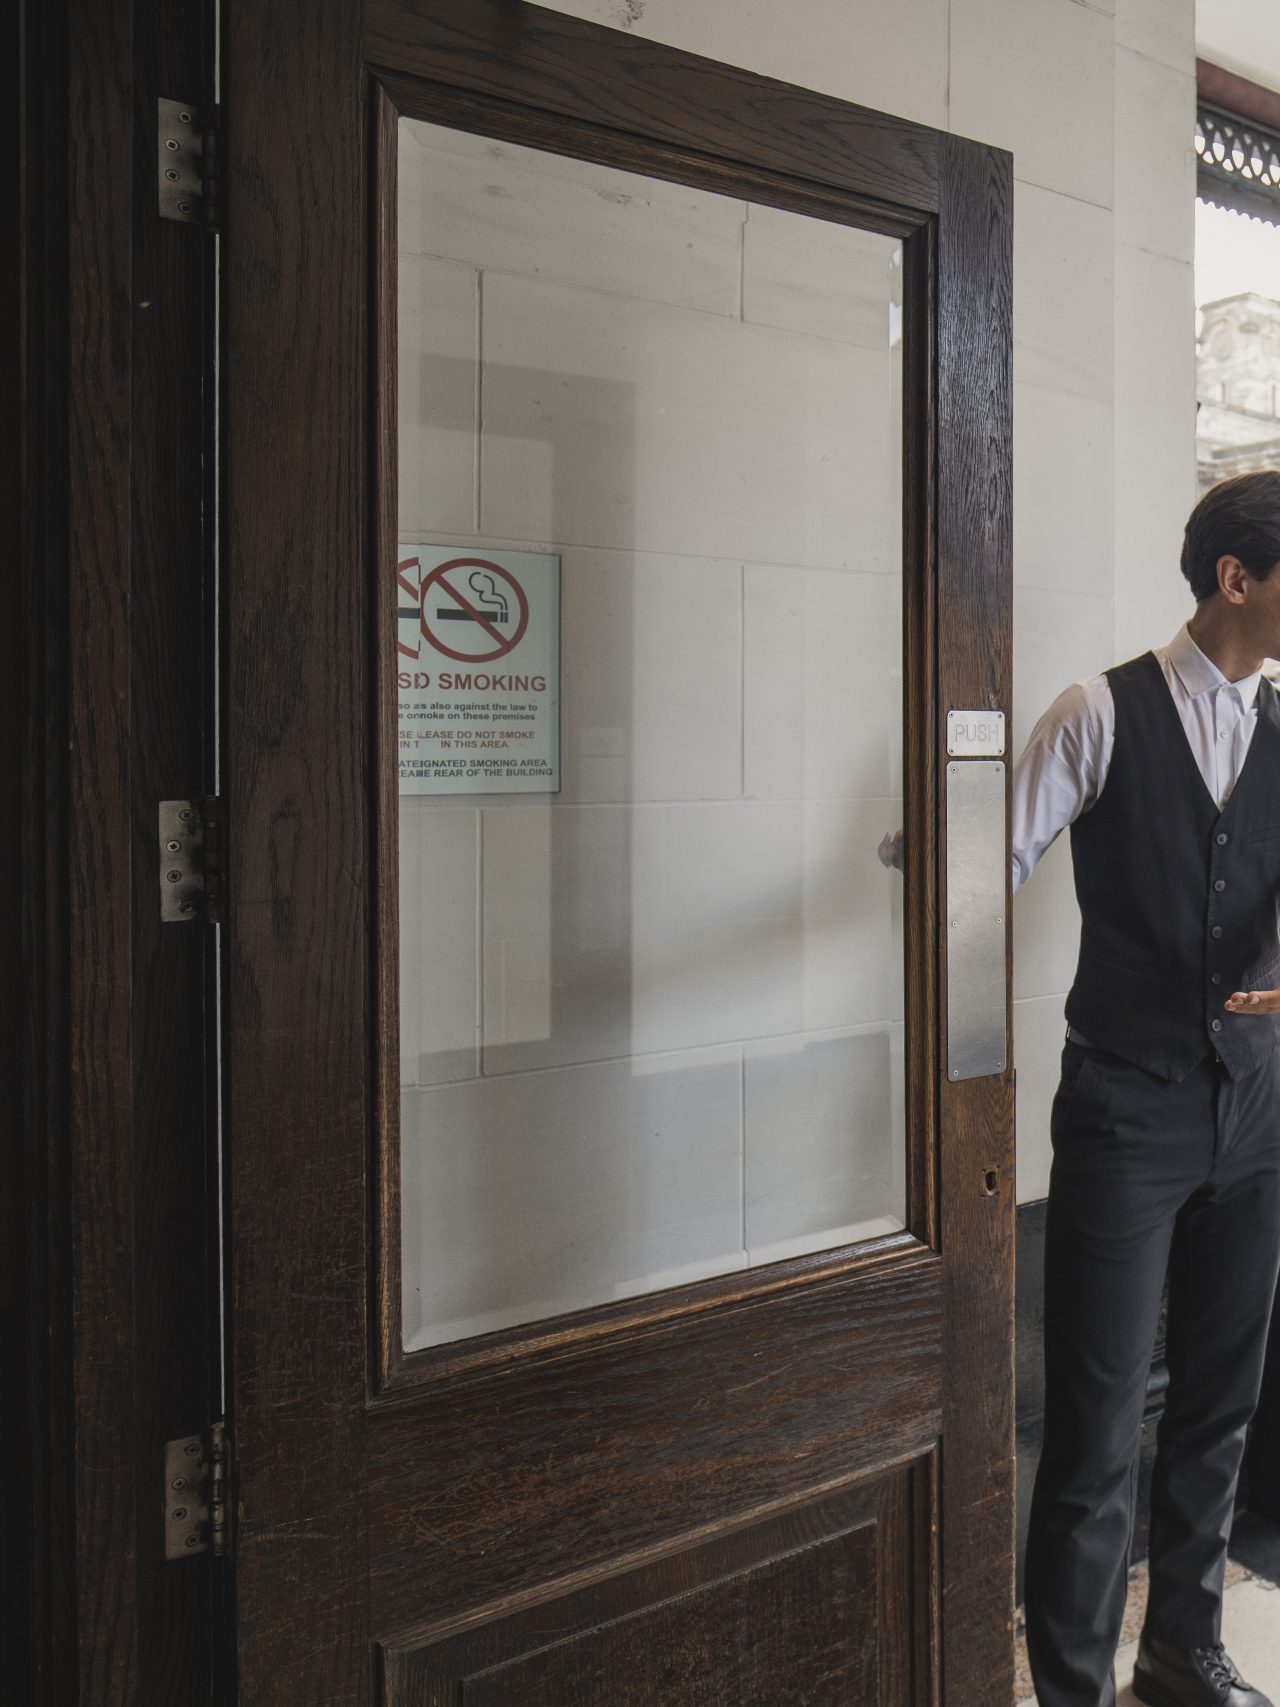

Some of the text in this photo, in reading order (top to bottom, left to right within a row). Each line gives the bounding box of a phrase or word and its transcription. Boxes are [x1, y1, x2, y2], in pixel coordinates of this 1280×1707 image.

[438, 673, 547, 692] SMOKING
[430, 702, 451, 710] also
[454, 703, 490, 711] against
[492, 703, 507, 711] the
[510, 703, 526, 711] law
[463, 712, 489, 720] these
[492, 713, 536, 721] premises
[457, 731, 472, 739] DO
[475, 731, 496, 739] NOT
[499, 731, 536, 739] SMOKE
[955, 723, 999, 742] PUSH
[470, 759, 517, 767] SMOKING
[520, 759, 548, 767] AREA
[434, 769, 463, 777] REAR
[506, 768, 553, 777] BUILDING
